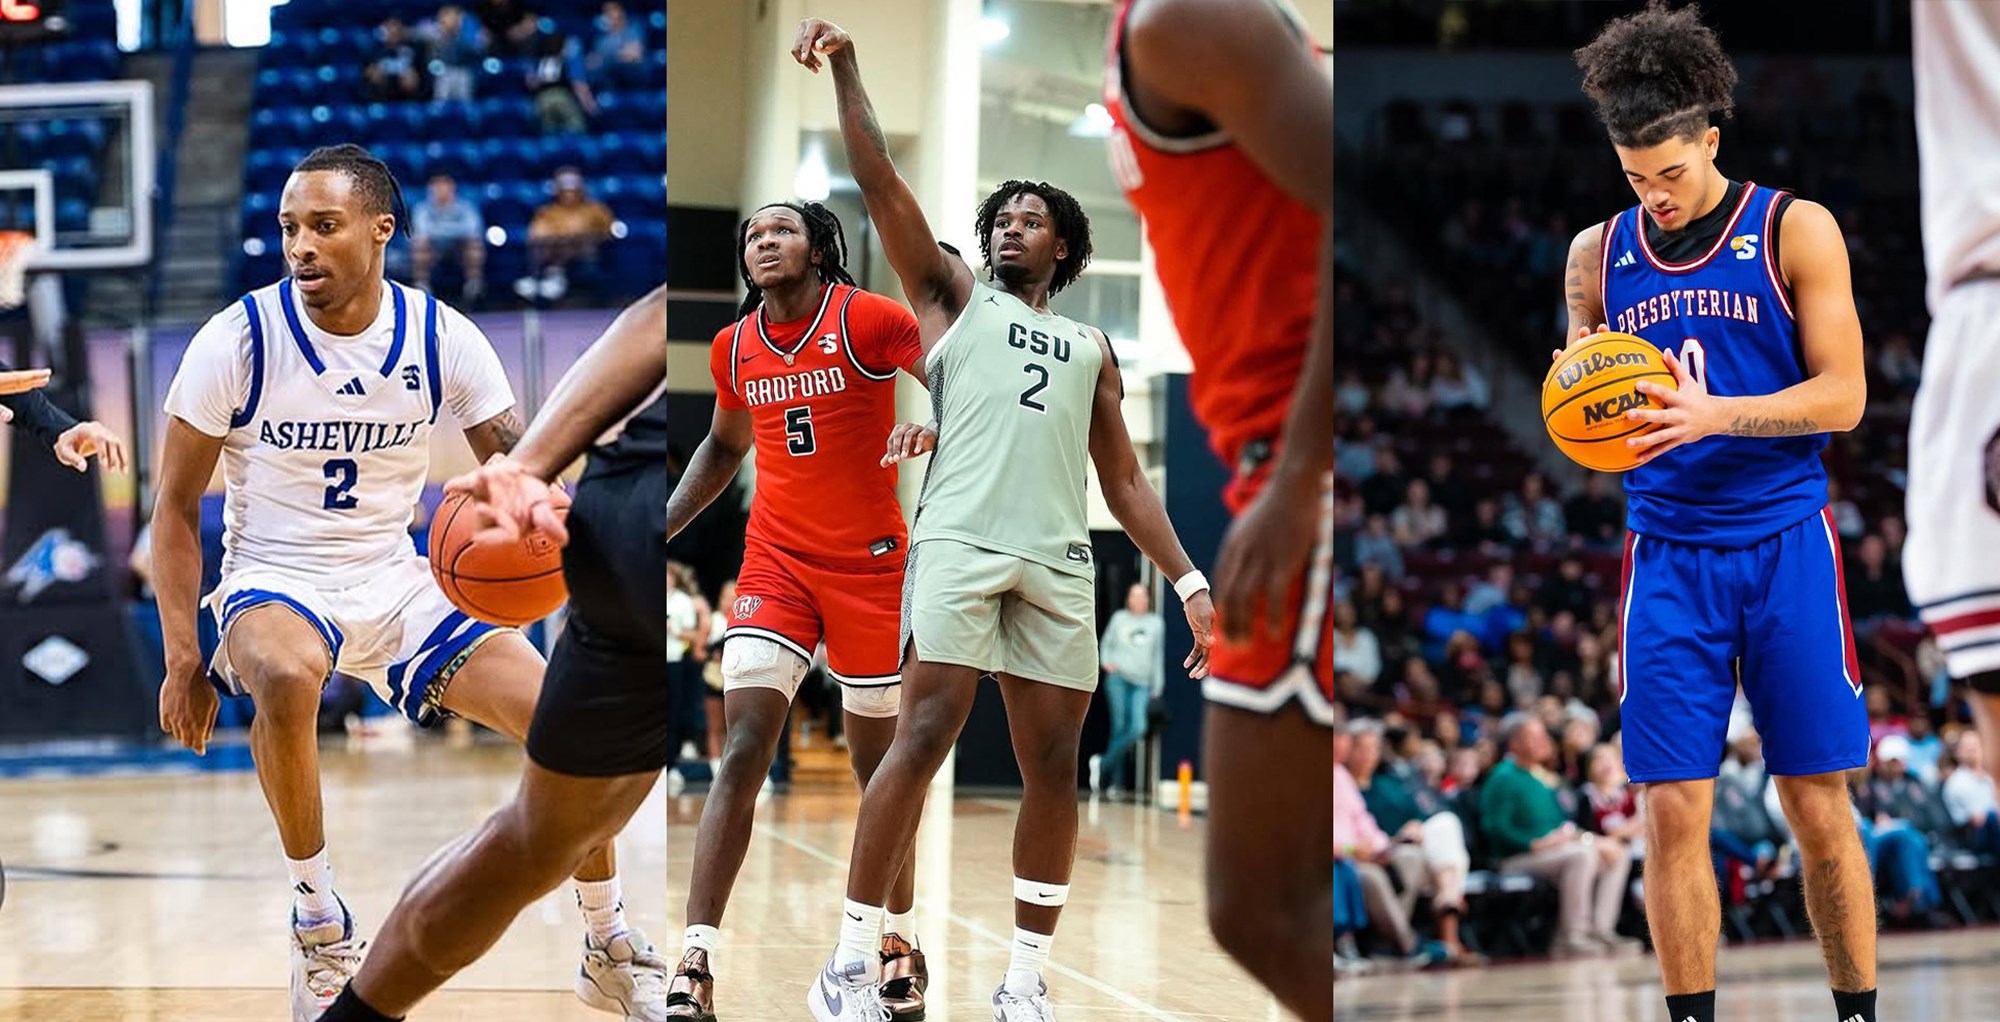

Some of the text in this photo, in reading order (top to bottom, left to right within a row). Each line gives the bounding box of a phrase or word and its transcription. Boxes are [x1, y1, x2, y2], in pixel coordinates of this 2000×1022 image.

[1616, 289, 1760, 335] PRESBYTERIAN
[1007, 321, 1071, 364] CSU
[744, 366, 847, 408] RADFORD
[1019, 361, 1050, 416] 2
[1556, 351, 1650, 392] Wilson
[1583, 387, 1650, 426] NCAA
[784, 404, 817, 458] 5
[322, 457, 360, 511] 2
